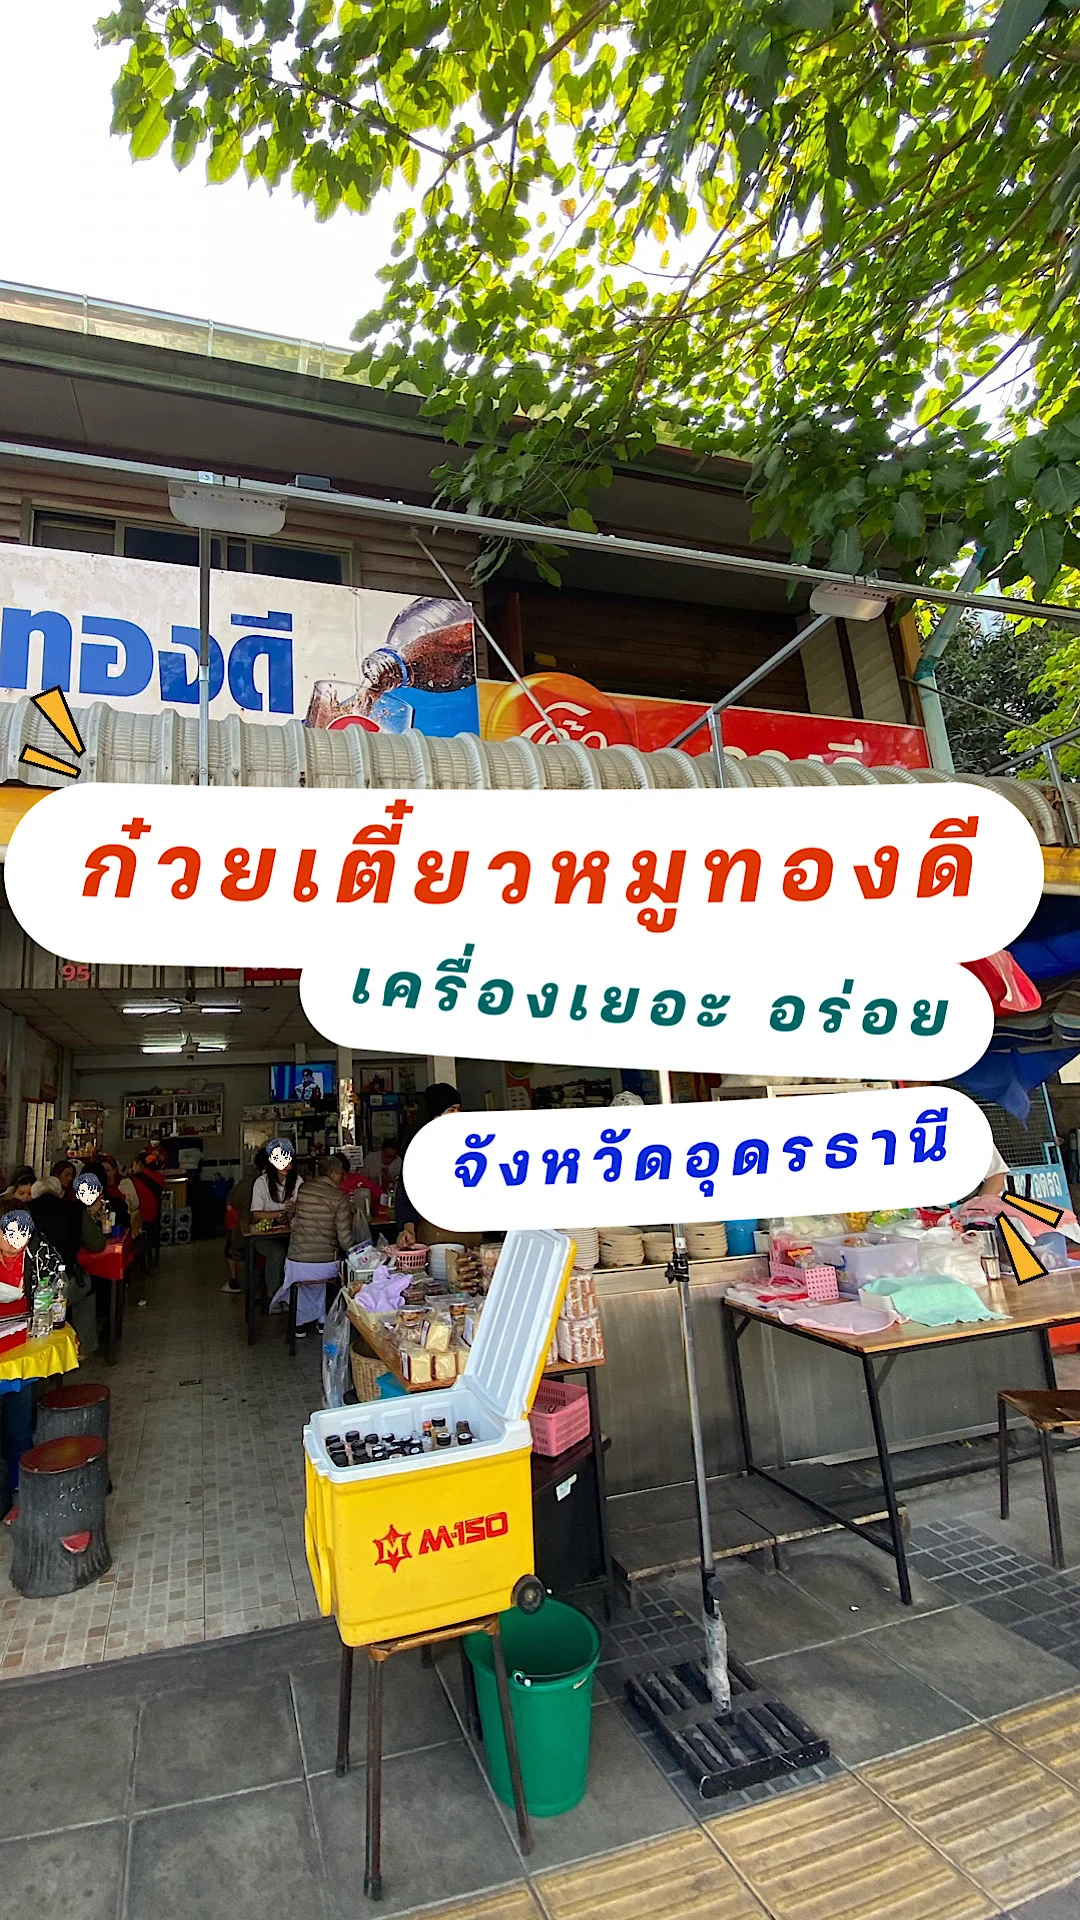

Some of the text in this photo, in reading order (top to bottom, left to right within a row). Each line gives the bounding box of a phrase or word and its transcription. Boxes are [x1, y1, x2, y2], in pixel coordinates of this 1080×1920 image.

[0, 607, 294, 714] ทองดี
[61, 963, 91, 983] 95
[418, 1511, 508, 1555] M-150
